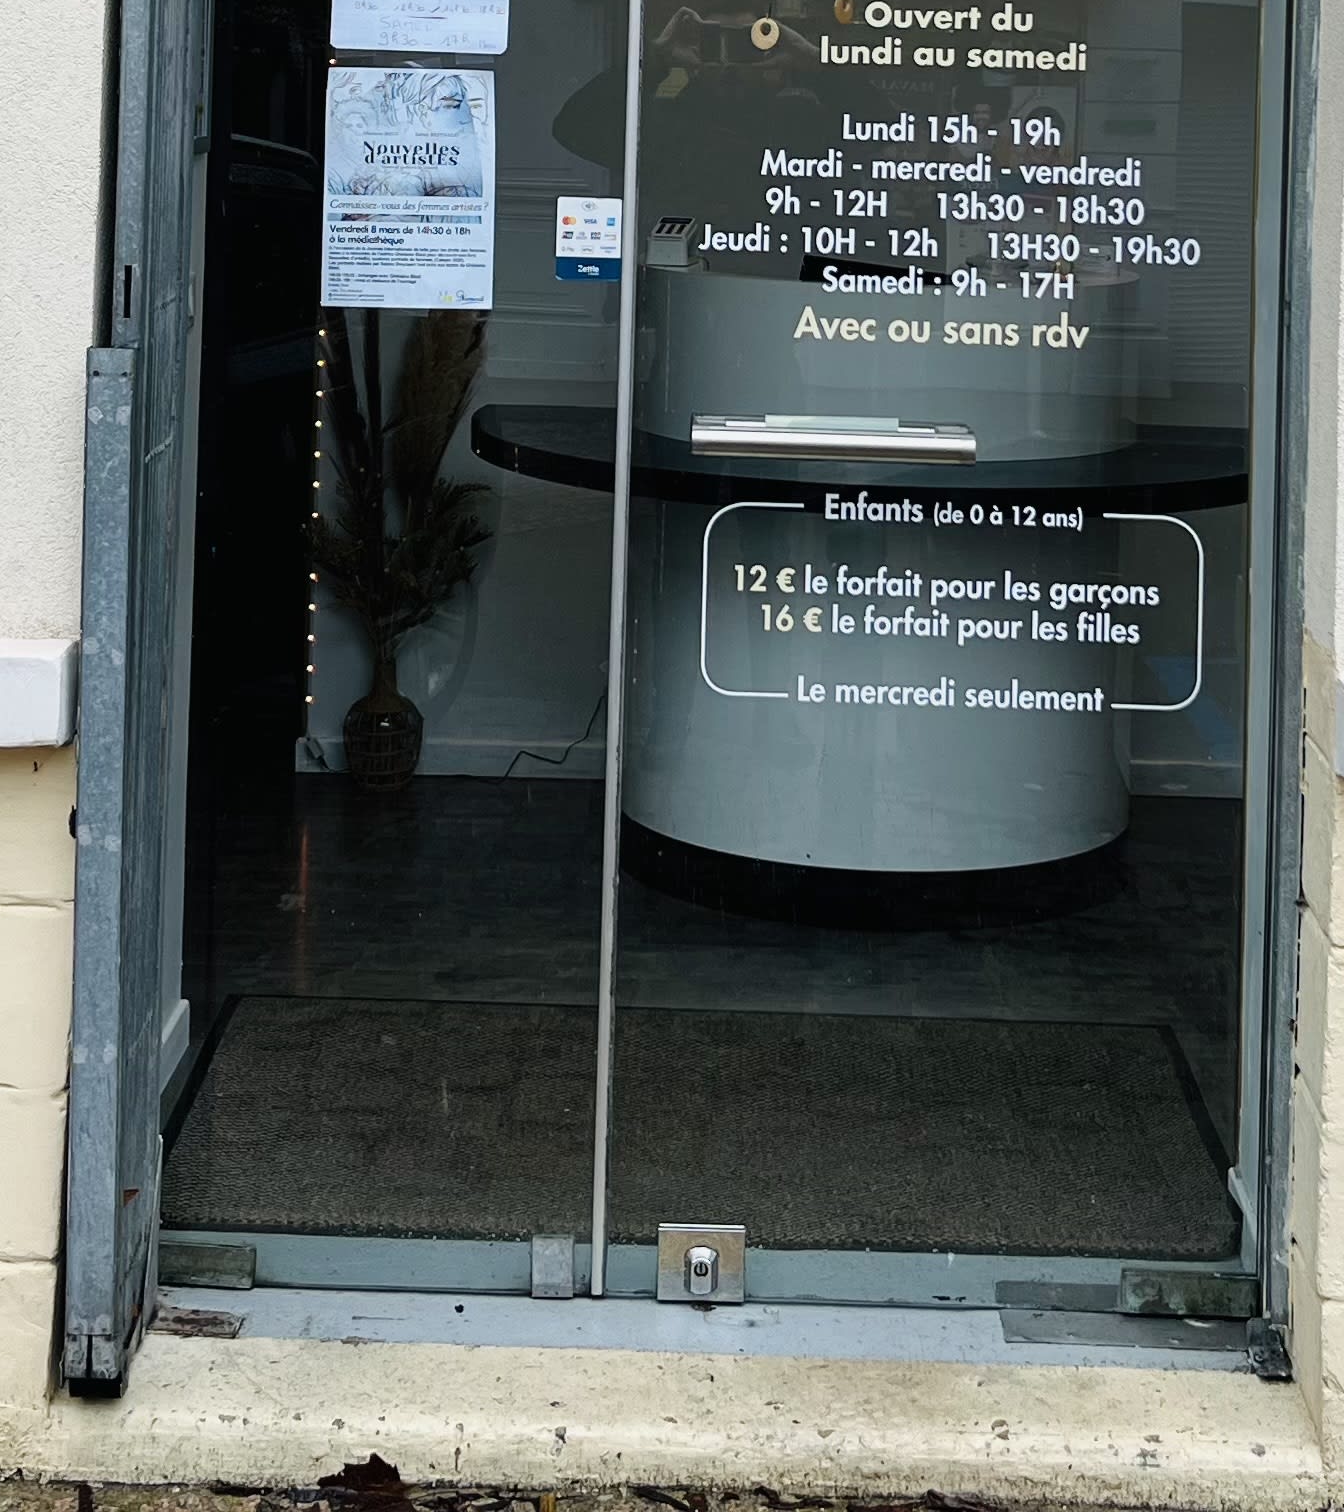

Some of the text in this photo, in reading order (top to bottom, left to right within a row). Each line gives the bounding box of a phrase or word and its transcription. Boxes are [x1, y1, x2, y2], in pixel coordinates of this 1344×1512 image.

[864, 1, 1033, 32] Ouvert du
[820, 35, 1087, 71] lundi au samedi
[363, 140, 460, 156] Nouvelles
[842, 112, 915, 142] Lundi
[927, 114, 978, 144] 15h
[1010, 116, 1061, 146] 19h
[760, 148, 843, 178] Mardi
[871, 152, 992, 182] mercredi
[1019, 155, 1141, 187] vendredi
[765, 185, 801, 215] 9h
[833, 189, 888, 217] 12H
[937, 190, 1025, 222] 13h30
[1056, 194, 1145, 226] 18h30
[329, 224, 369, 234] Vendredi
[370, 225, 377, 234] 8
[402, 225, 414, 235] de
[416, 226, 444, 235] 14h30
[455, 226, 471, 236] 18h
[337, 234, 346, 243] la
[697, 222, 770, 252] Jeudi
[801, 226, 856, 255] 10H
[888, 227, 938, 257] 12h
[987, 232, 1080, 262] 13H30
[1112, 234, 1201, 266] 19h30
[821, 265, 924, 295] Samedi
[951, 267, 987, 297] 9h
[1019, 271, 1074, 300] 17H
[793, 305, 1090, 349] Avec ou sans rdv
[824, 491, 1084, 531] Enfants (de 0 à 12 ans)
[734, 564, 1160, 610] 12 € le forfait pour les garçons
[761, 603, 1141, 646] 16 € le forfait pour les filles
[797, 674, 1104, 712] Le mercredi seulement
